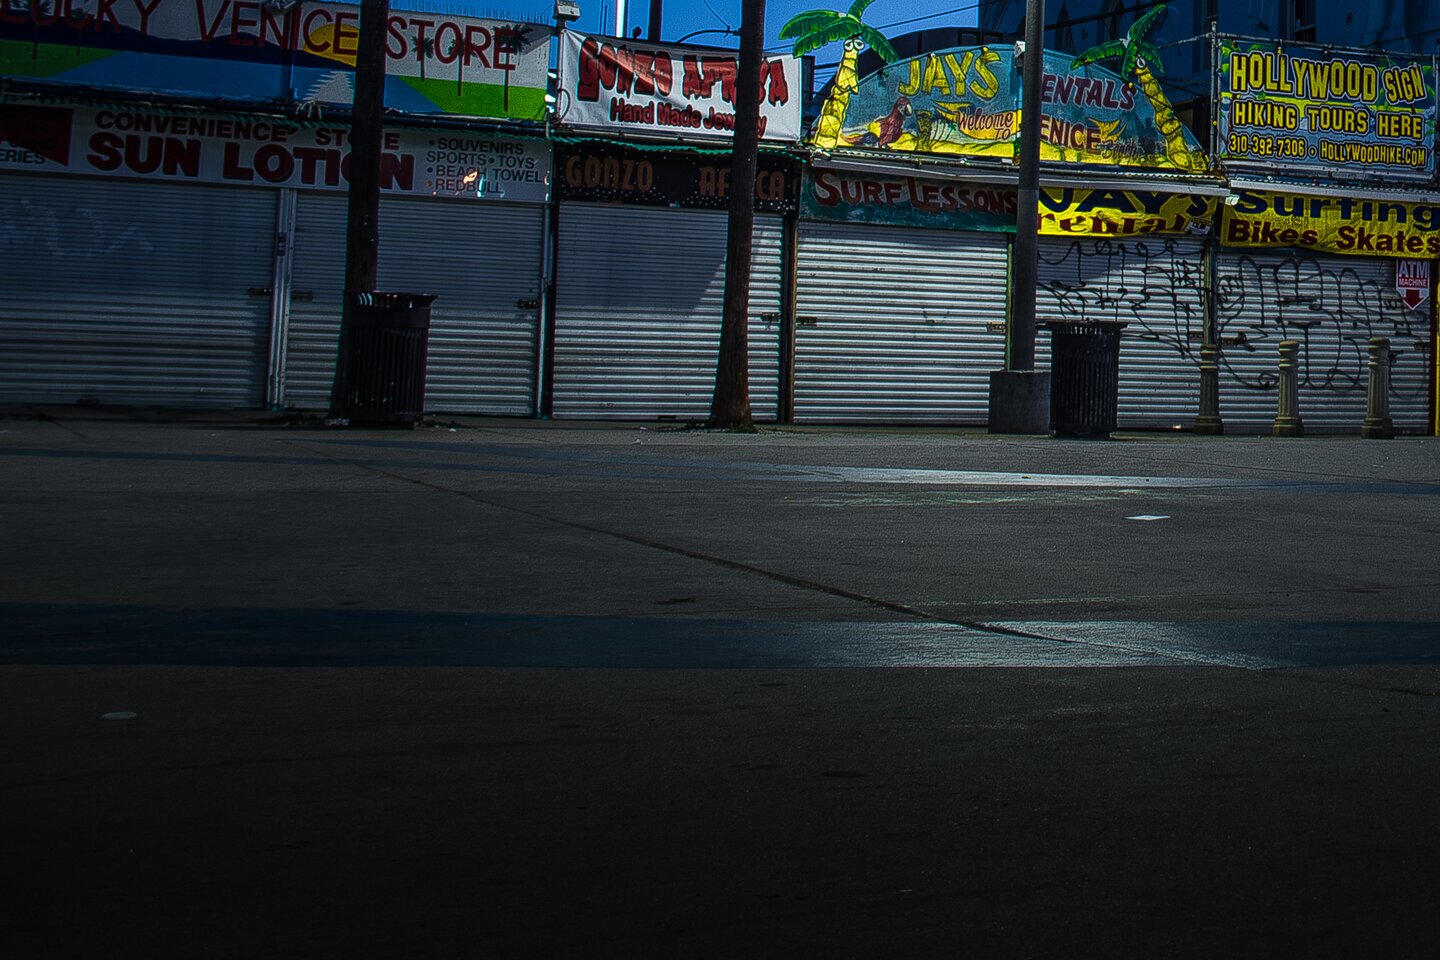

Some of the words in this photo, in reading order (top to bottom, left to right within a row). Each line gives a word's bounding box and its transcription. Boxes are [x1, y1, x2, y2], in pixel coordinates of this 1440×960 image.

[385, 16, 519, 71] STORE
[577, 36, 673, 101] GONZO
[683, 54, 789, 110] AFRA
[898, 47, 1002, 99] JAYS
[1231, 52, 1378, 102] HOLLYWOOD
[1384, 65, 1426, 104] SIGN
[1041, 74, 1138, 111] ENTALS
[97, 111, 288, 142] CONVENIENCE
[315, 127, 401, 150] STE
[610, 97, 655, 125] Hand
[657, 102, 702, 129] Made
[703, 106, 768, 139] Jewy
[956, 107, 1014, 131] Welcome
[993, 128, 1011, 141] TO
[1040, 114, 1102, 156] ENICE
[1234, 101, 1298, 130] HIKING
[1307, 106, 1369, 133] TOURS
[1377, 113, 1424, 139] HERE
[86, 131, 201, 177] SUN
[223, 141, 415, 191] LOTIN
[426, 150, 487, 166] SPORTS
[496, 155, 535, 170] TOYS
[437, 137, 525, 155] SOUVENIRS
[1229, 134, 1306, 158] 310-392-7306
[1320, 141, 1426, 167] HOLLYWOODHIKE.COM
[436, 165, 487, 179] BEACH
[492, 168, 543, 183] TOWEL
[564, 155, 654, 191] GONZO
[700, 166, 785, 201] AFCA
[813, 168, 903, 207] SURF
[908, 177, 1018, 214] LESSONS
[1227, 218, 1319, 246] Bikes
[1398, 278, 1428, 288] MACHINE
[1399, 260, 1428, 277] ATM
